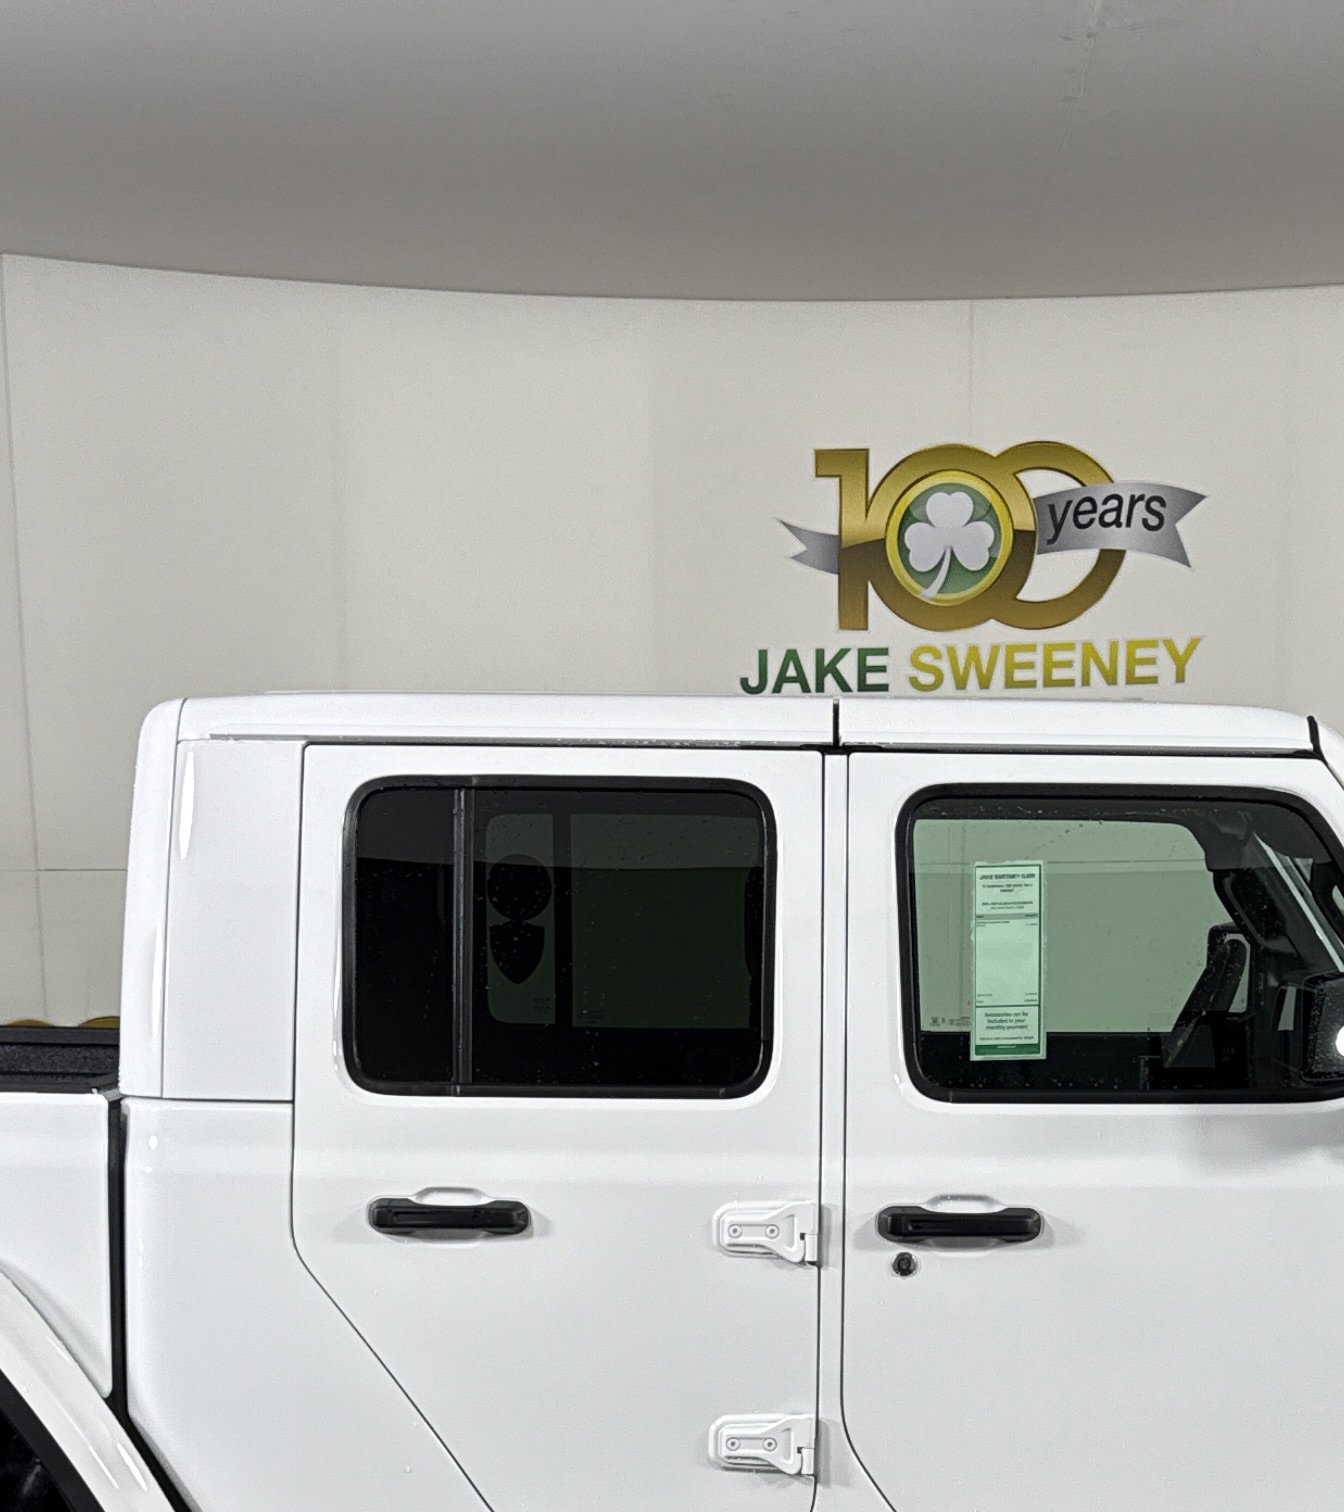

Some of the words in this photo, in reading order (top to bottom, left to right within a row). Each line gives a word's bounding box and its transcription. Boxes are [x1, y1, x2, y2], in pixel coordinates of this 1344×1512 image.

[814, 441, 1126, 630] 100
[1046, 492, 1167, 545] years
[740, 647, 890, 695] JAKE
[908, 637, 1200, 691] SWEENEY
